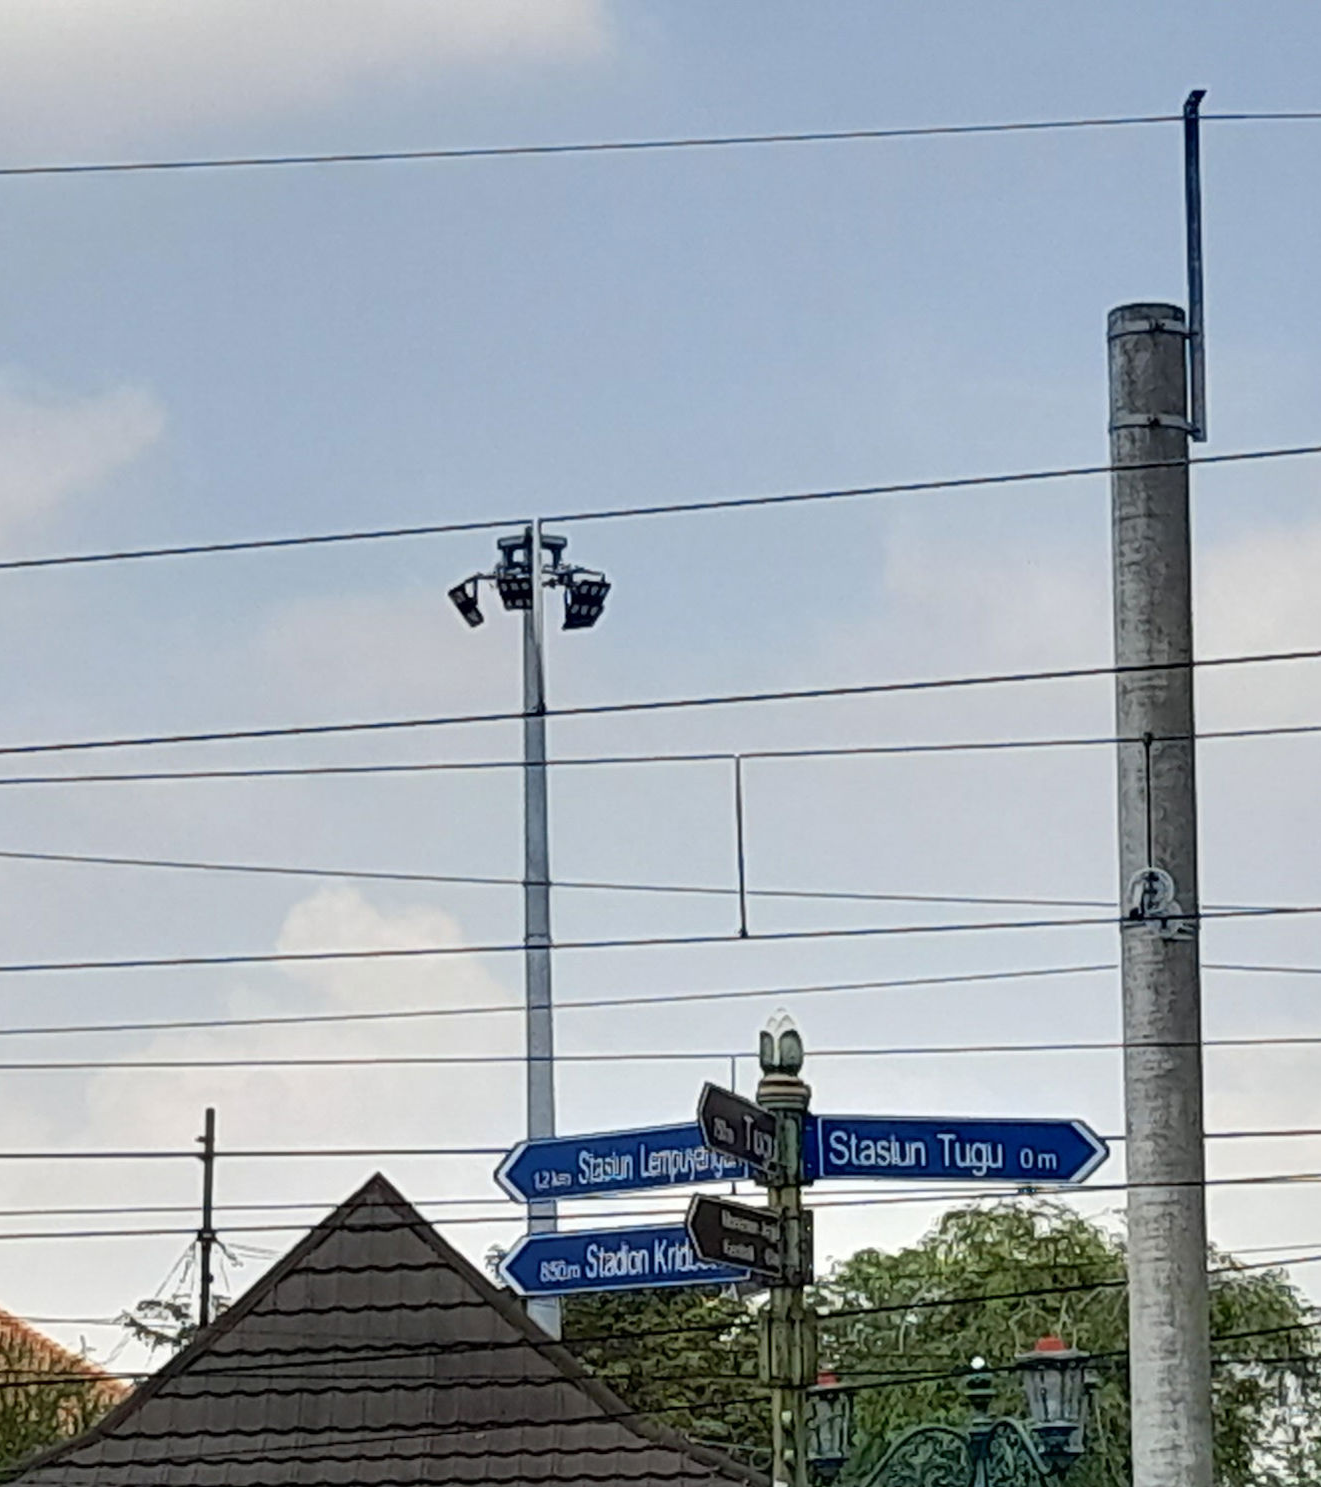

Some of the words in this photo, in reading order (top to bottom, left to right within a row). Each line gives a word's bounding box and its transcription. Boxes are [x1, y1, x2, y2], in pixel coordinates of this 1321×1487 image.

[578, 1150, 634, 1185] Stasiun
[829, 1130, 926, 1167] Stasiun
[937, 1133, 1003, 1177] Tugu
[1020, 1146, 1034, 1169] 0
[1038, 1150, 1057, 1170] m
[585, 1242, 649, 1279] Stadion
